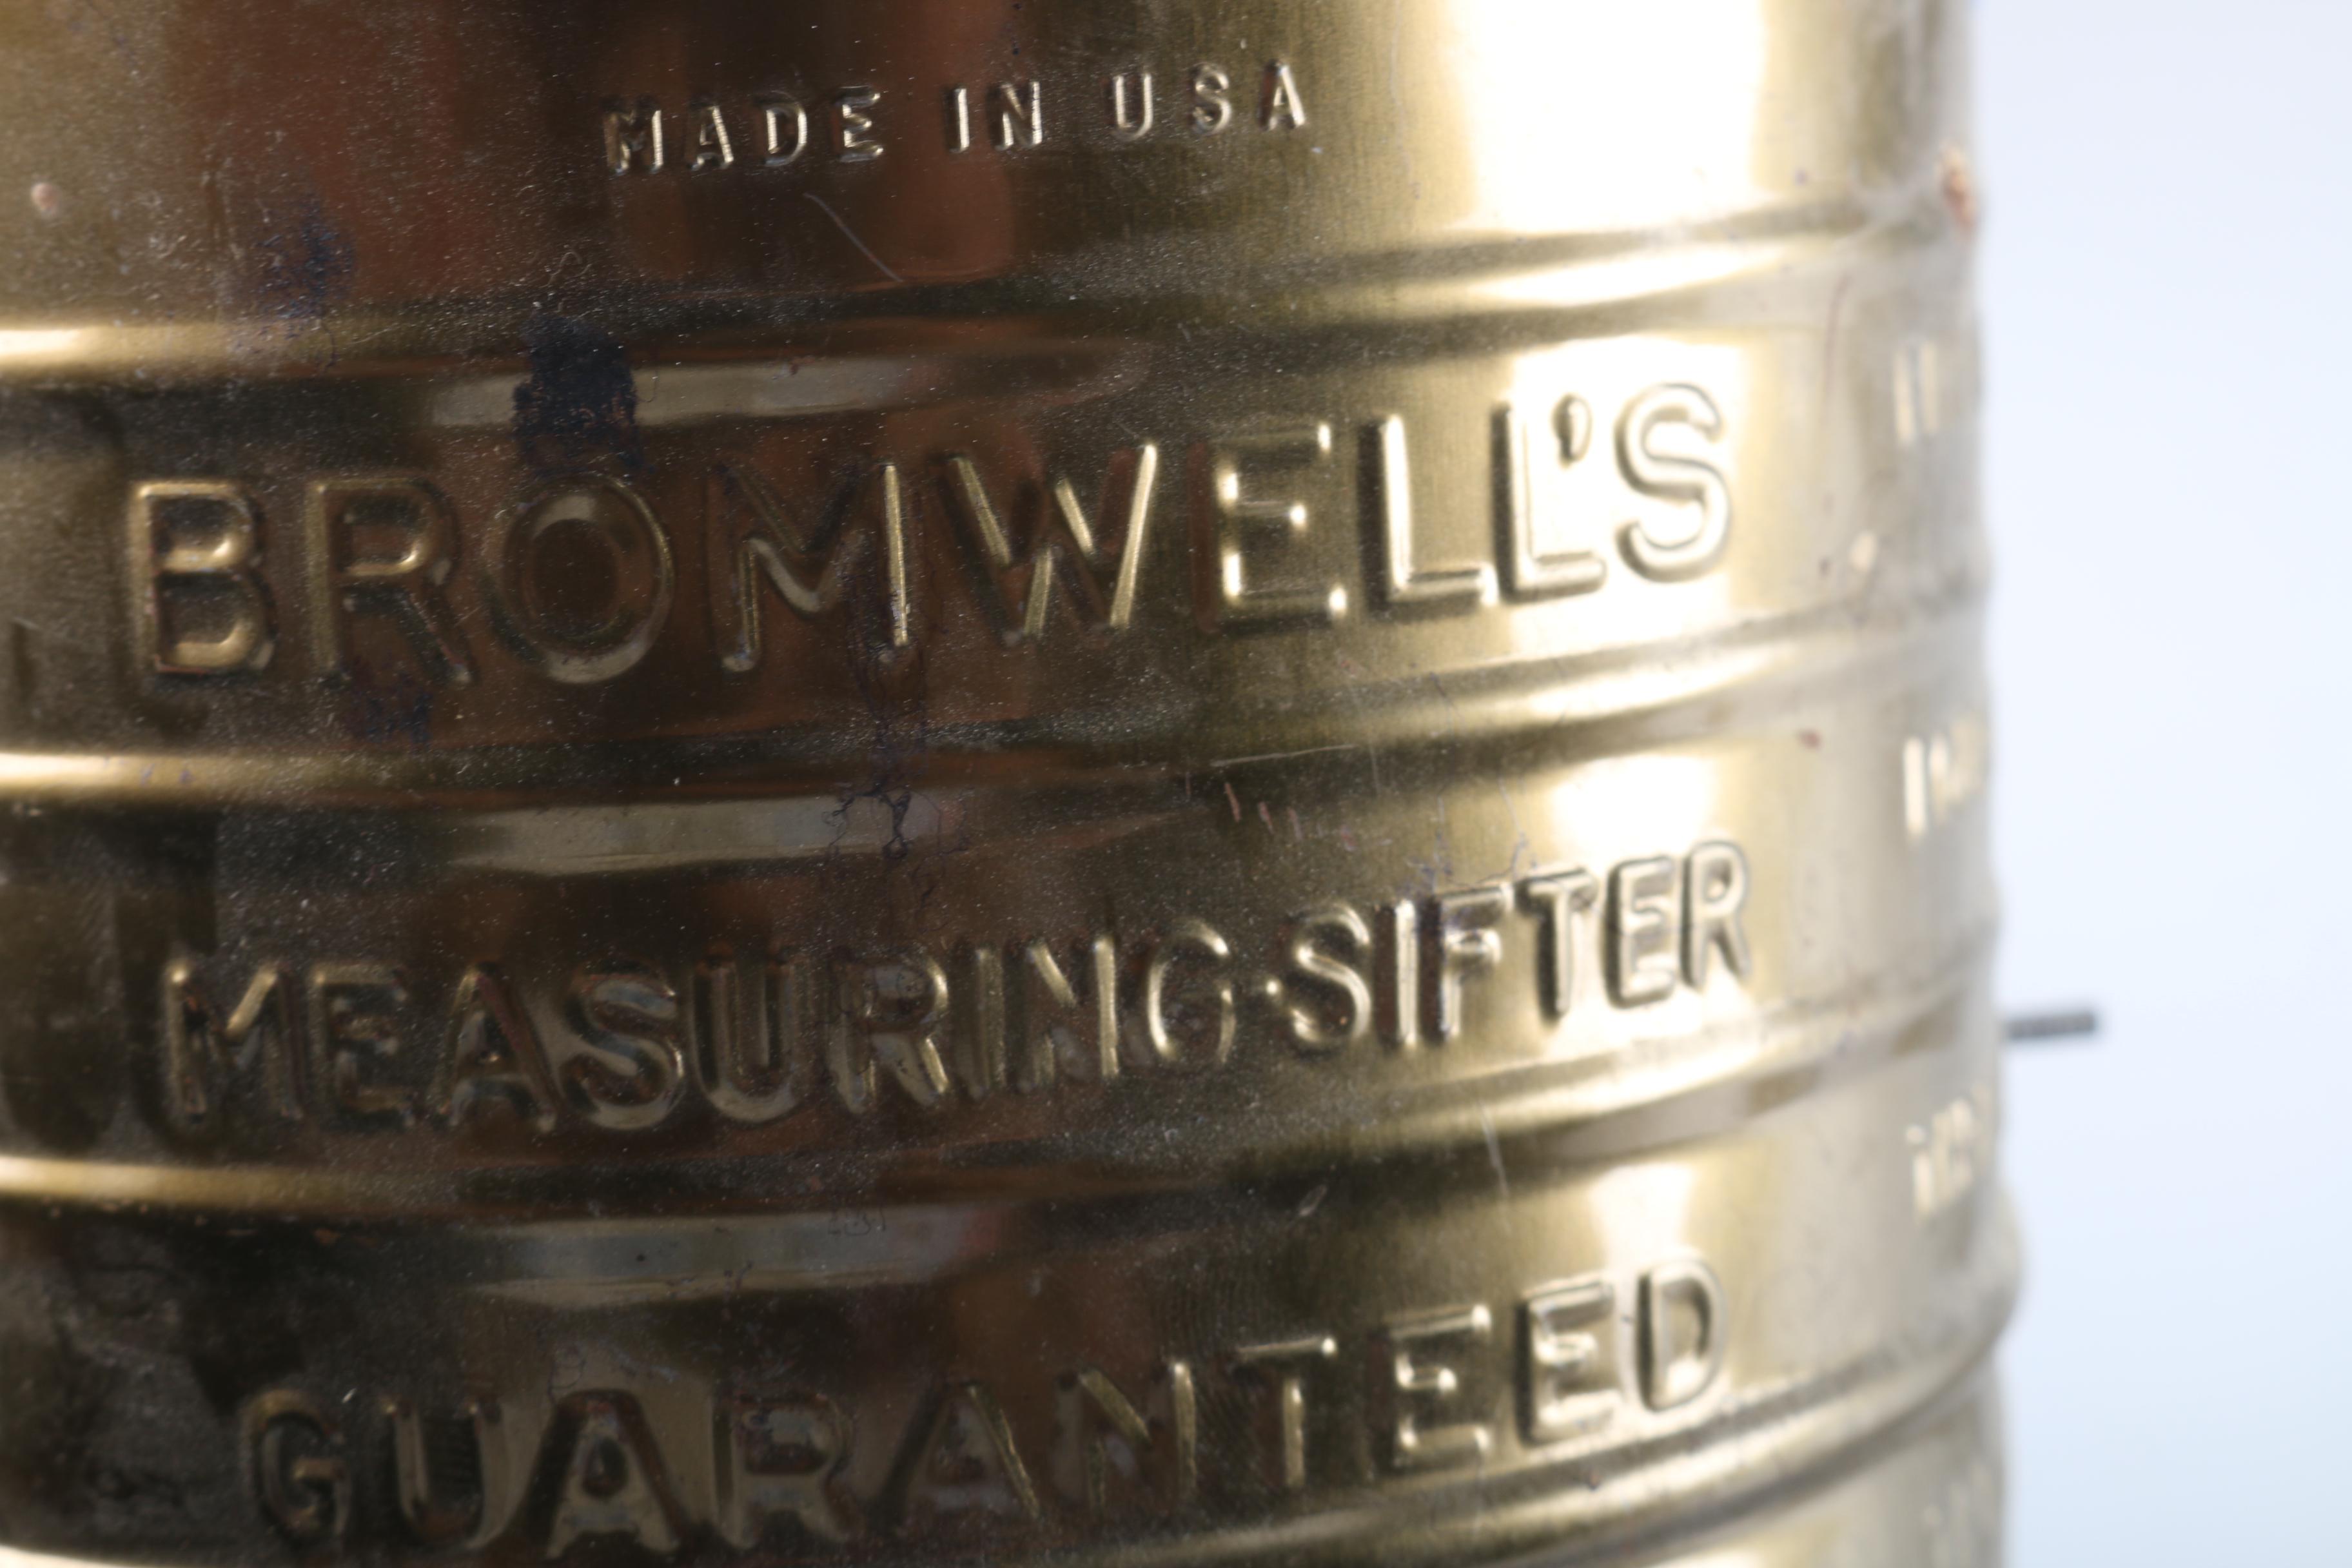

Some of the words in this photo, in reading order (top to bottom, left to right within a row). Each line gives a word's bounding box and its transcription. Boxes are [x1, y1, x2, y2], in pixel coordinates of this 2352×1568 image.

[601, 83, 886, 174] MADE
[946, 79, 1045, 155] IN
[1108, 59, 1308, 143] USA
[128, 382, 1733, 686] BROMWELL'S
[239, 1256, 1728, 1560] GUARANTEED
